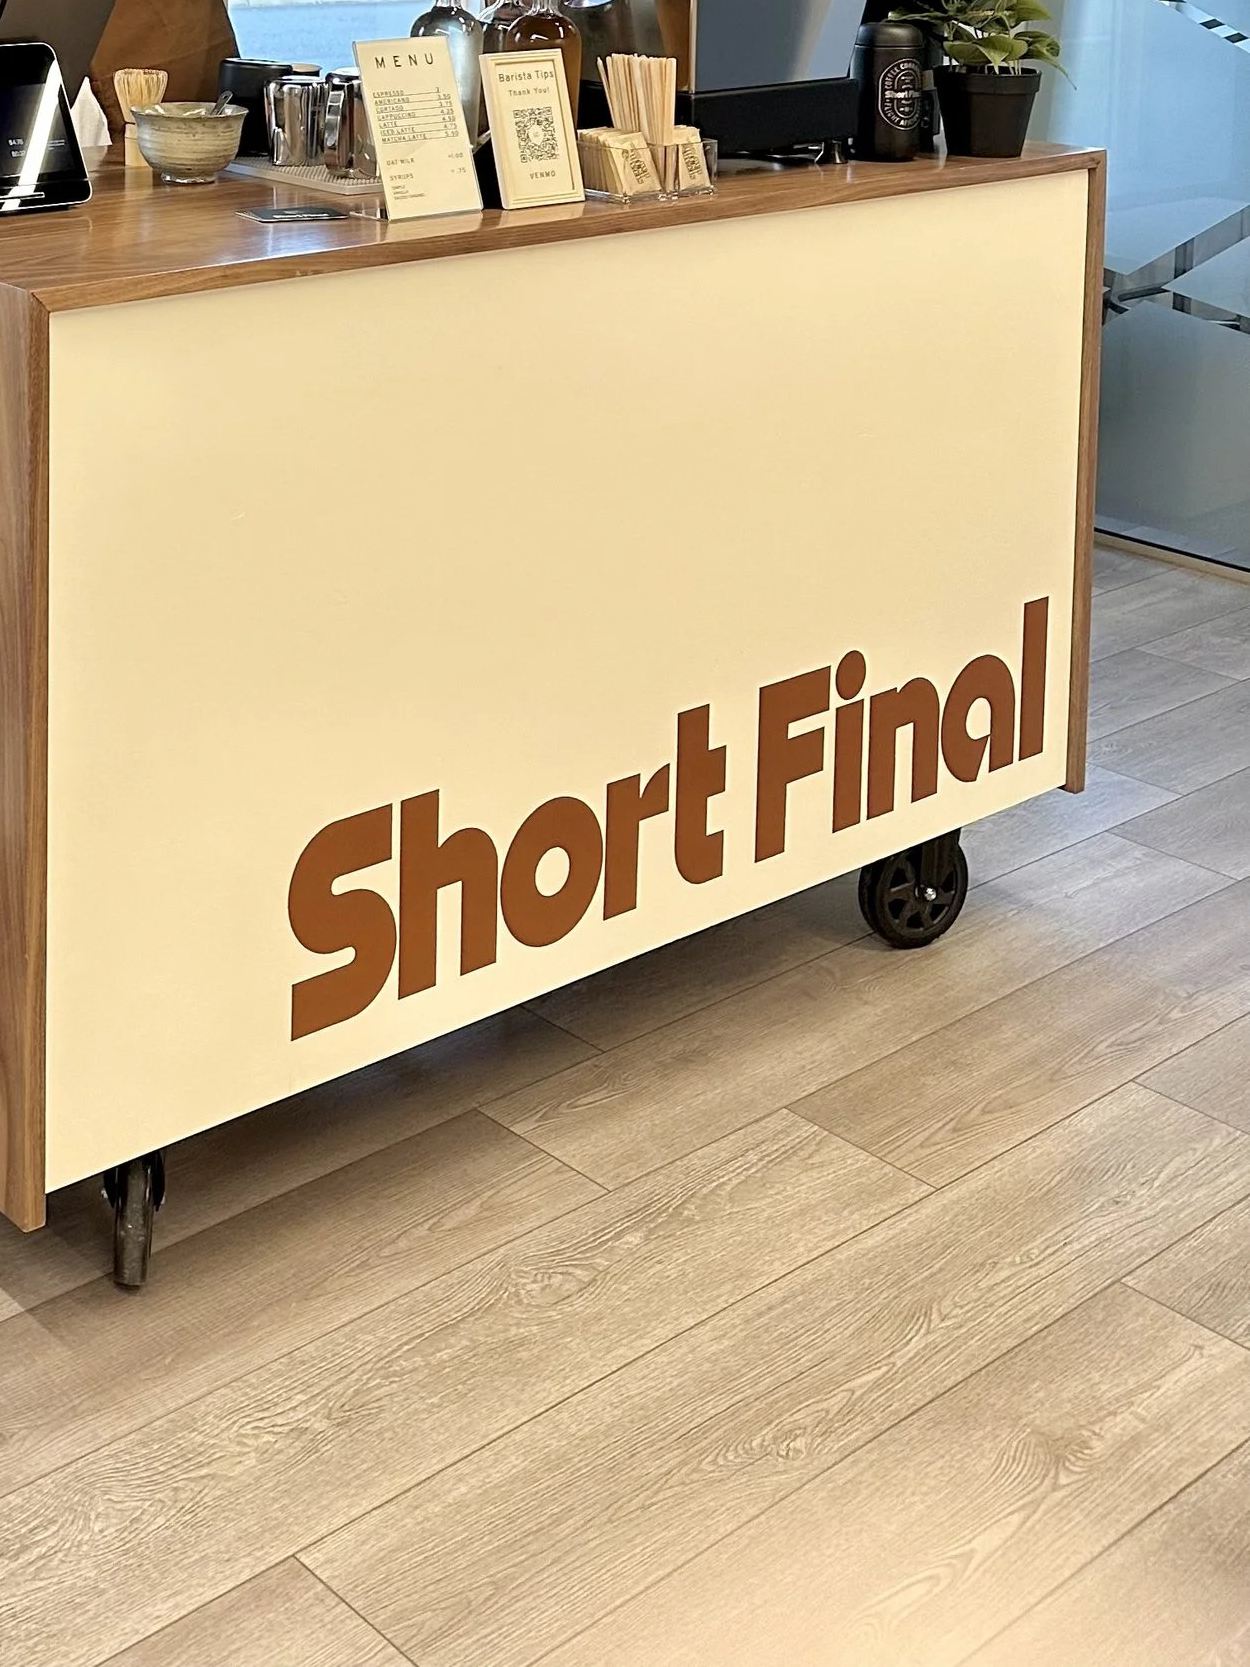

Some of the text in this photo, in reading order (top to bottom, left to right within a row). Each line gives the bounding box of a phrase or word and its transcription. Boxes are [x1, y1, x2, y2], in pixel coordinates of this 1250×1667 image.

[374, 52, 434, 69] MENU
[498, 70, 555, 83] Barista Tips
[372, 90, 404, 98] ESPRESSO
[508, 86, 550, 97] Thank You!
[374, 97, 410, 106] AMERICANO
[377, 112, 416, 121] CAPPUCCINO
[379, 121, 398, 129] LATTE
[380, 129, 396, 137] ICED
[397, 127, 415, 135] LATTE
[381, 134, 407, 143] MATCHA
[408, 133, 428, 141] LATTE
[386, 158, 398, 166] OAT
[390, 173, 414, 181] SYRUPS
[530, 170, 556, 179] VENMO
[287, 596, 1049, 1041] Short Final
